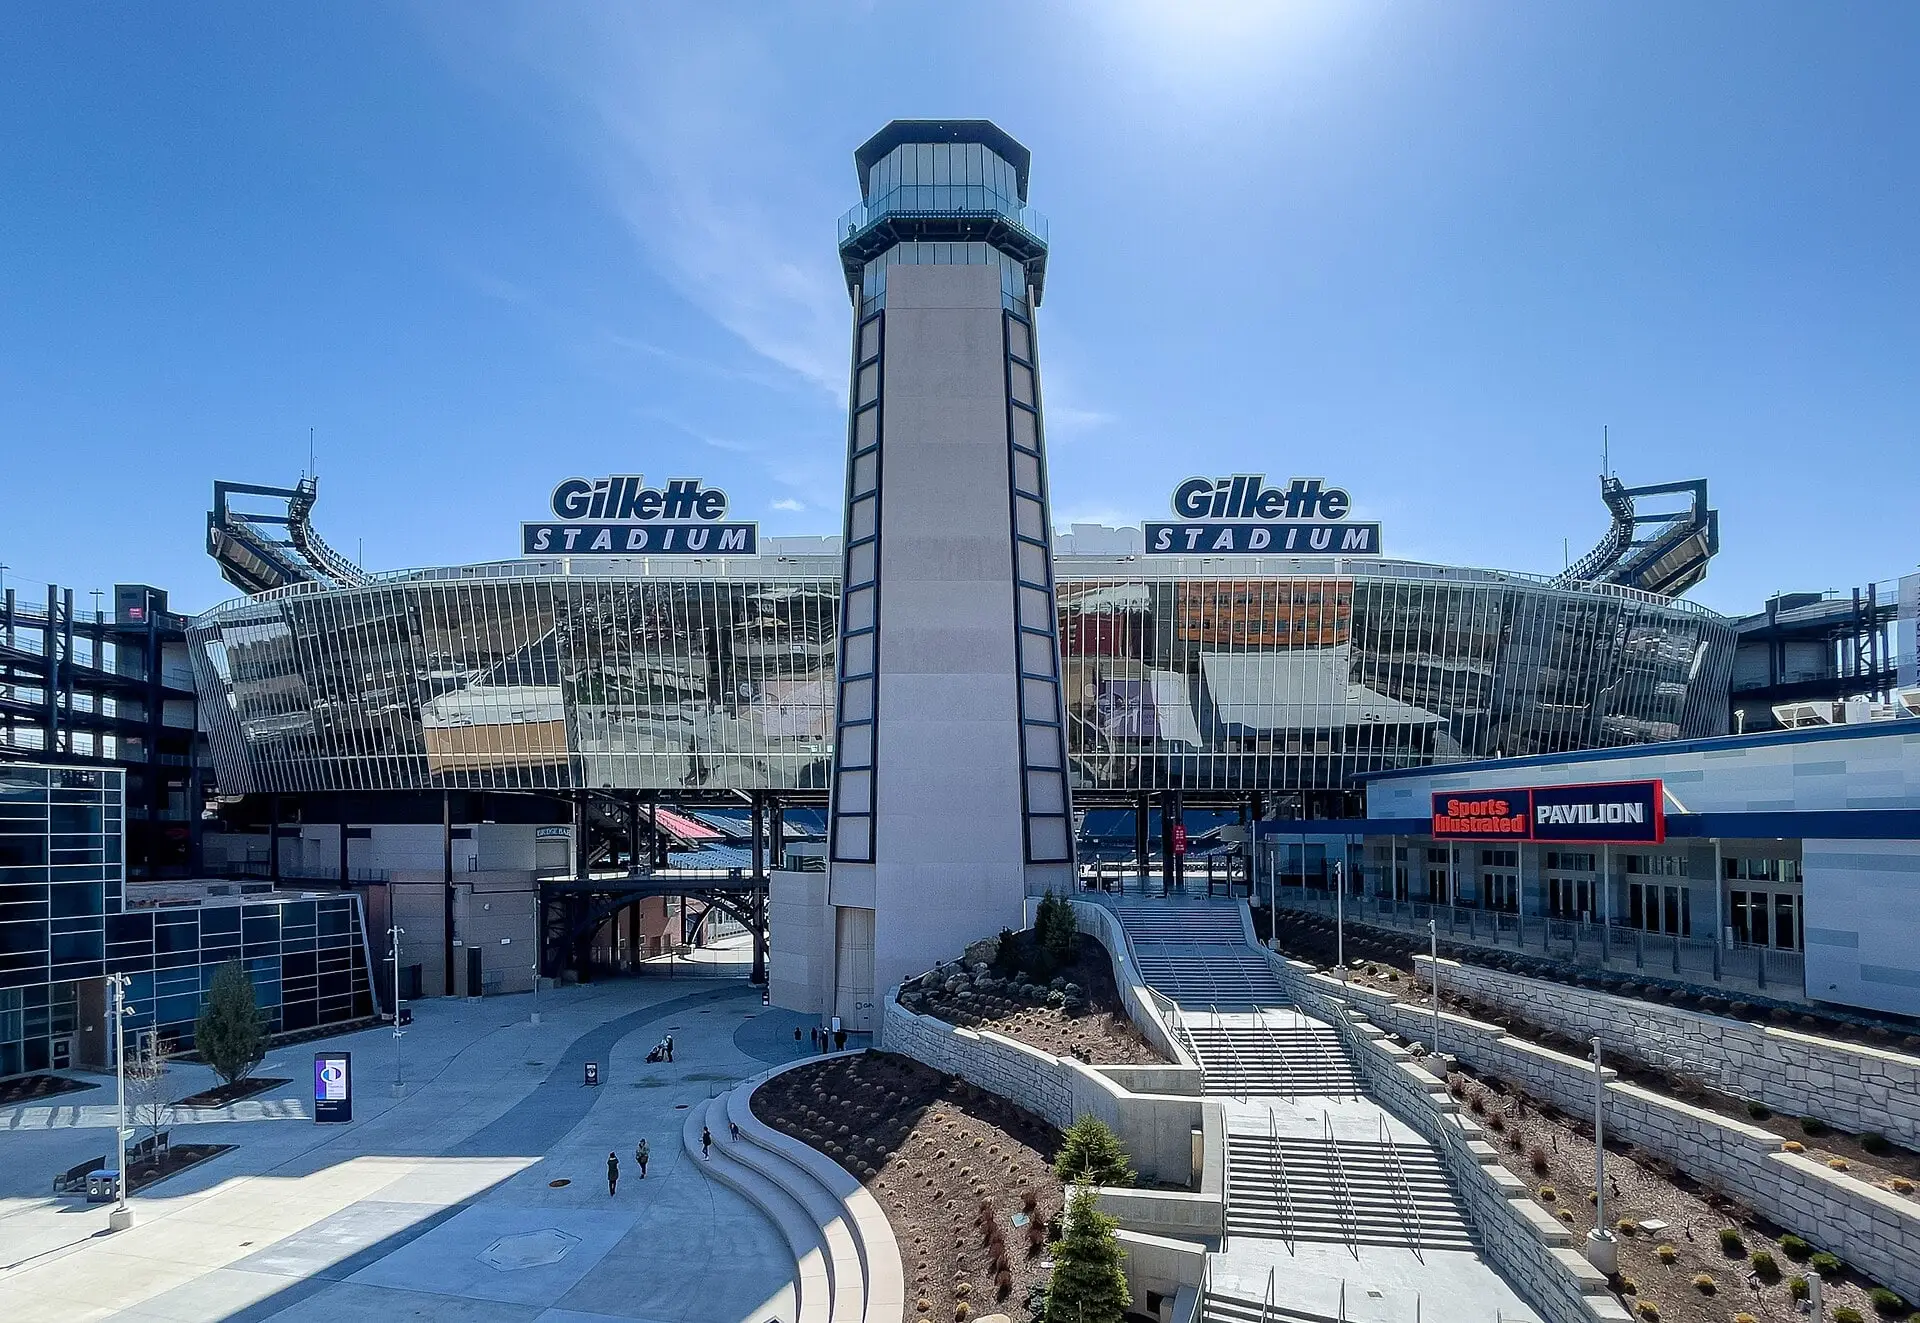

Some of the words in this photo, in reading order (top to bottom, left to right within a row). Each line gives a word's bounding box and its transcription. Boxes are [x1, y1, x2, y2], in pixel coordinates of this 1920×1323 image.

[552, 476, 727, 520] Gillette
[1173, 475, 1350, 520] Gillette
[533, 528, 748, 551] STADIUM
[1154, 527, 1371, 550] STADIUM
[1447, 799, 1508, 818] Sports
[1536, 802, 1644, 824] PAVILION
[1435, 813, 1525, 833] Illustrated
